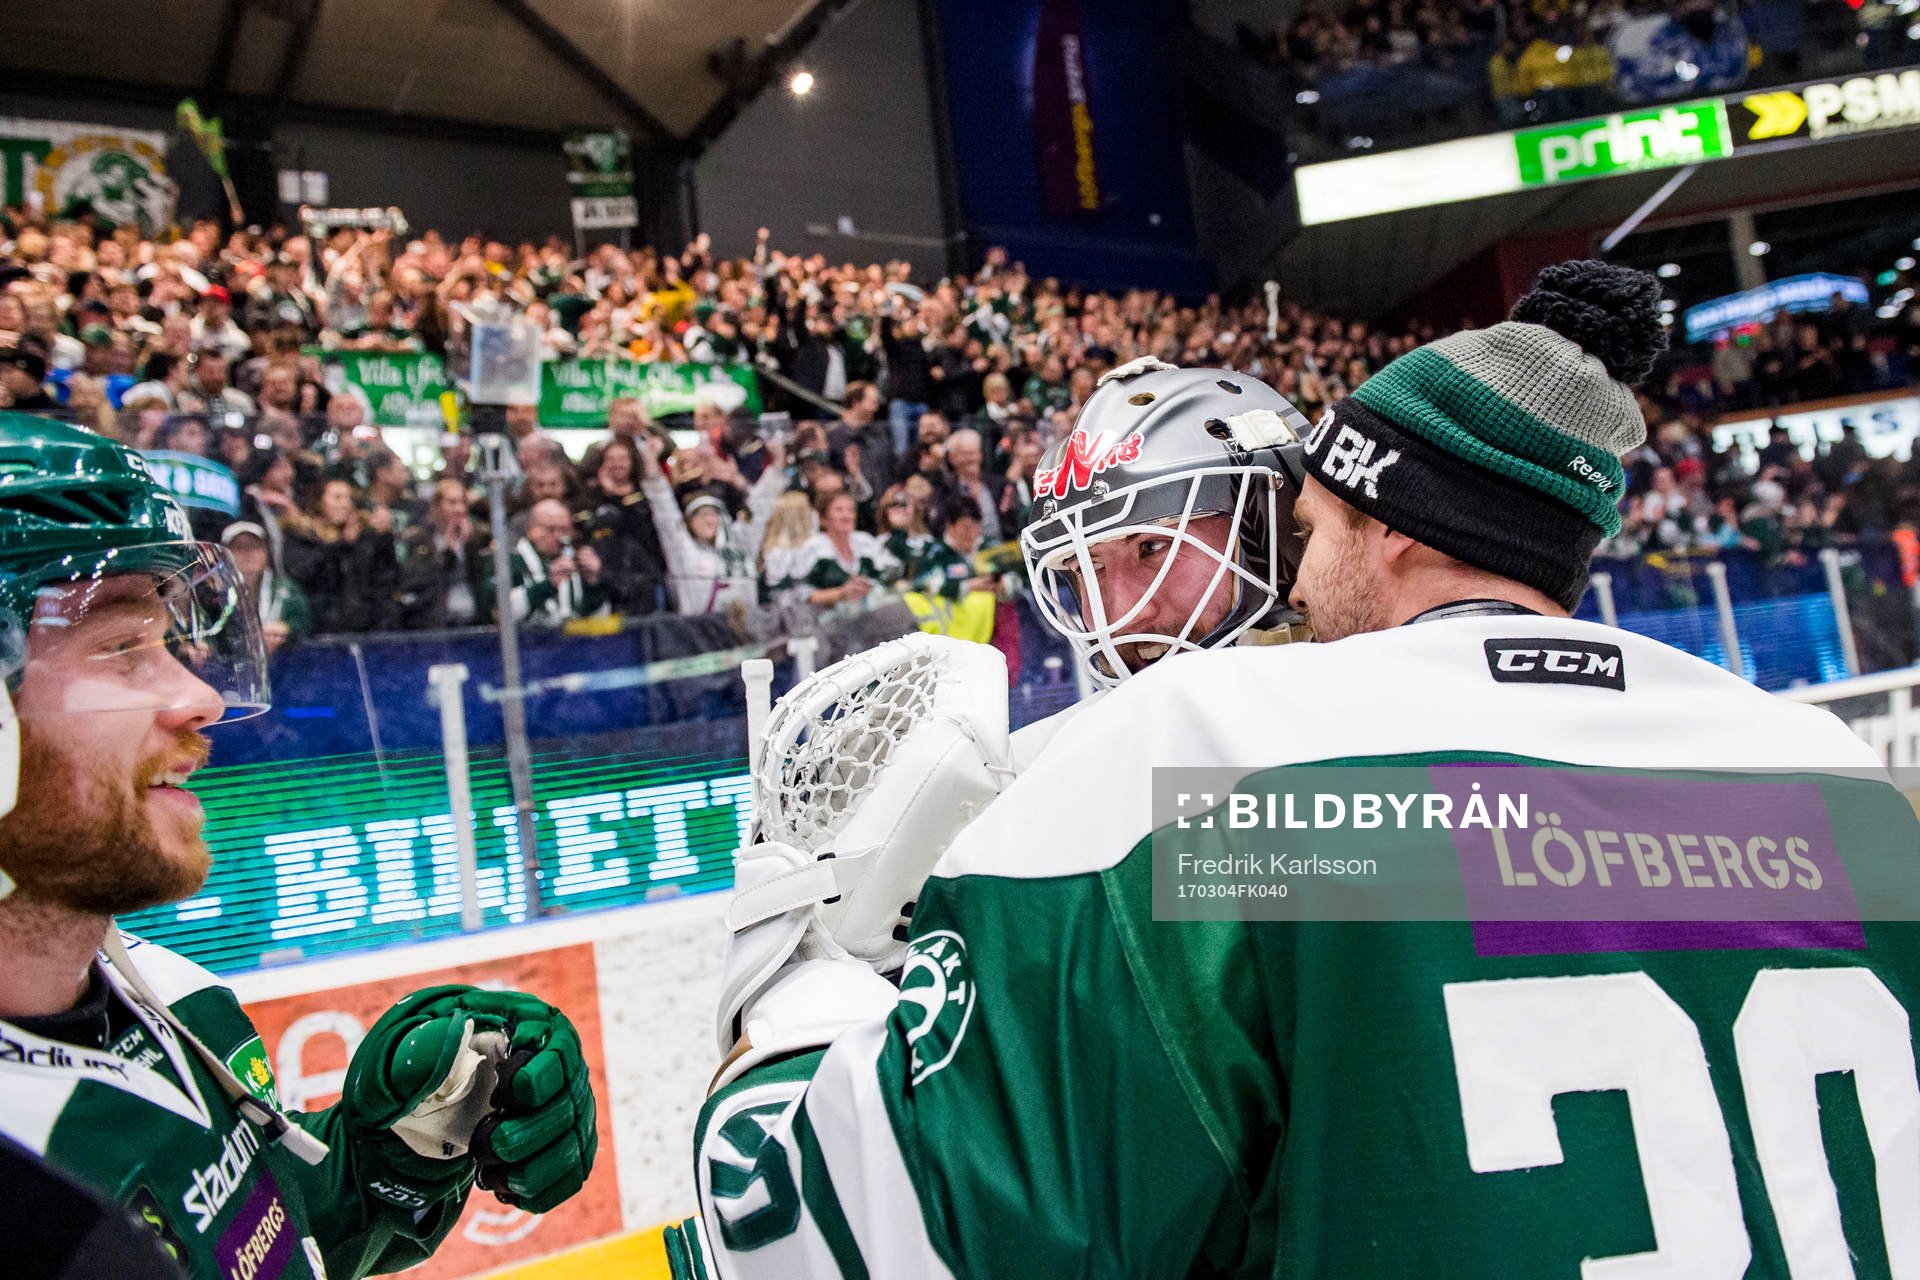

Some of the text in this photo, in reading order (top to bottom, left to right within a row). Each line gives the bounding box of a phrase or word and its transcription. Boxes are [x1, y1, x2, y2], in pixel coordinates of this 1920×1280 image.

[1539, 109, 1703, 184] print
[1322, 424, 1401, 499] BK
[1496, 649, 1619, 678] CCM
[1491, 812, 1824, 890] LÖFBERGS
[182, 1119, 259, 1234] stadium
